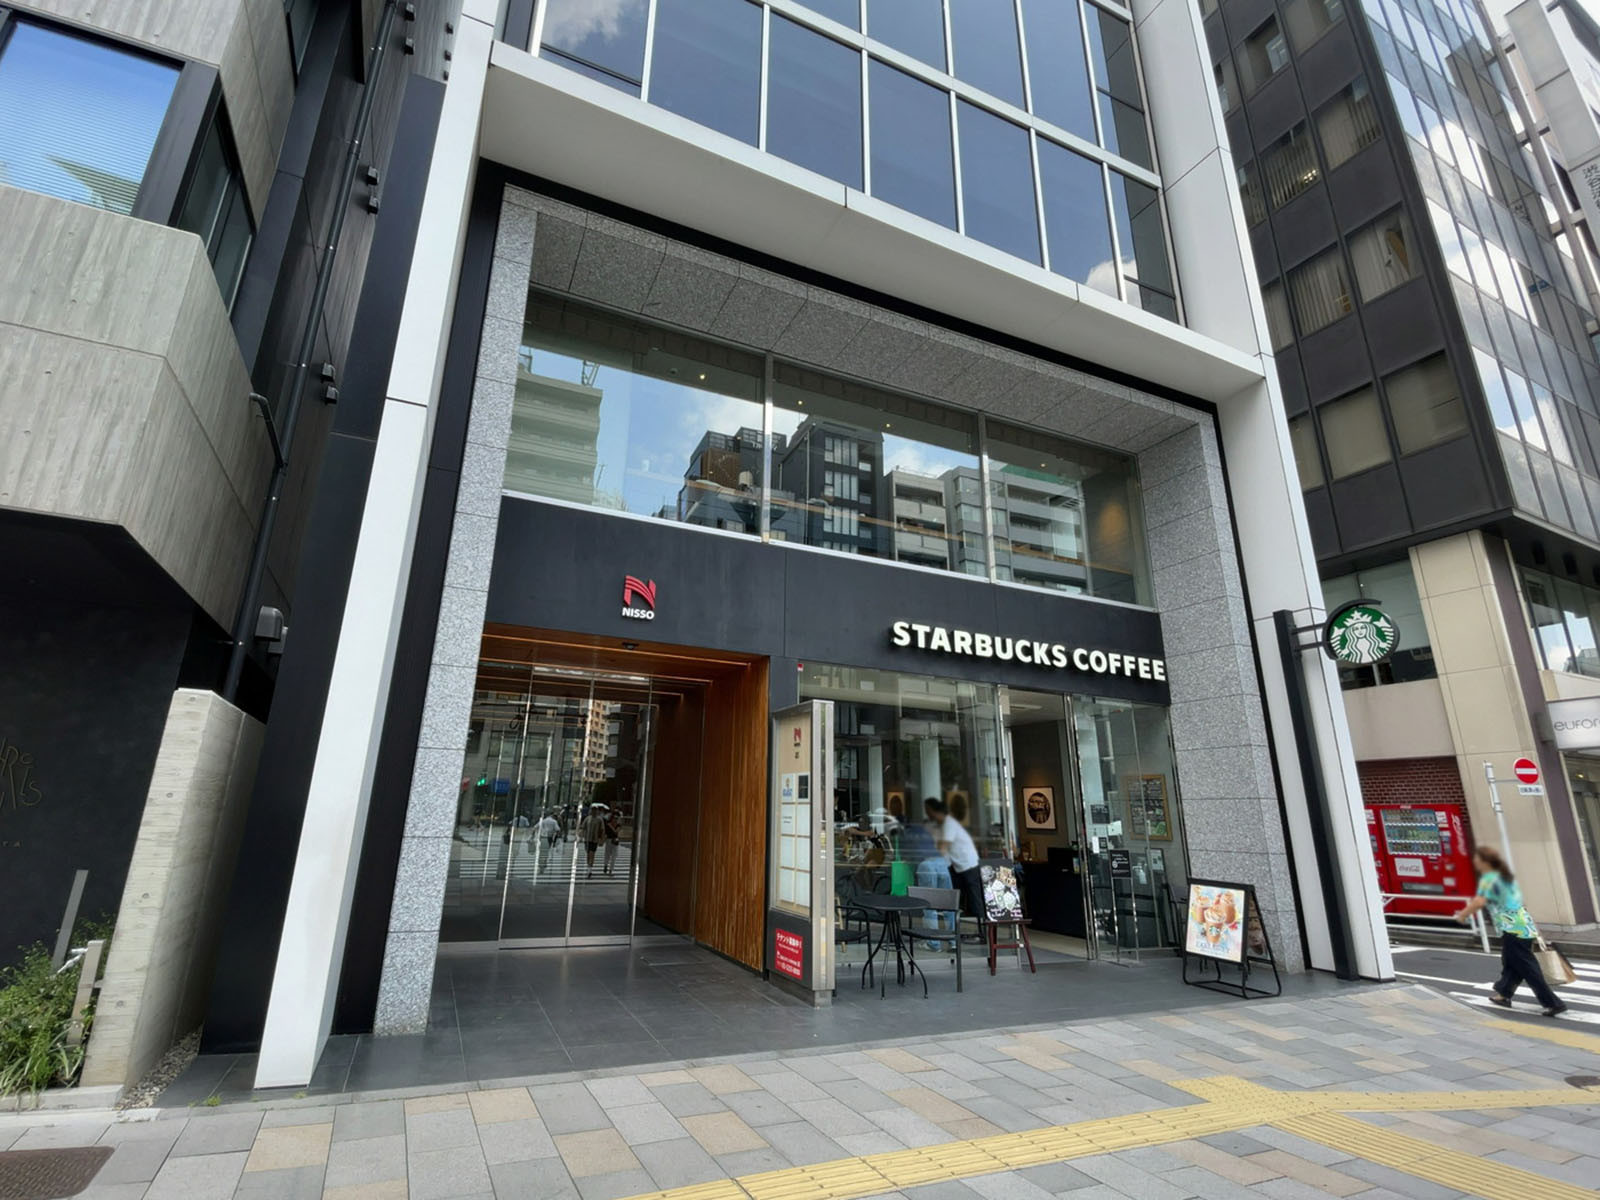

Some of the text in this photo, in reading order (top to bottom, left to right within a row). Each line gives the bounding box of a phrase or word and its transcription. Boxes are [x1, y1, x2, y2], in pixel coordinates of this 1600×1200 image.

[622, 607, 655, 620] NISSO
[892, 621, 1167, 682] STARBUCKS COFFEE
[1554, 718, 1600, 731] eufor
